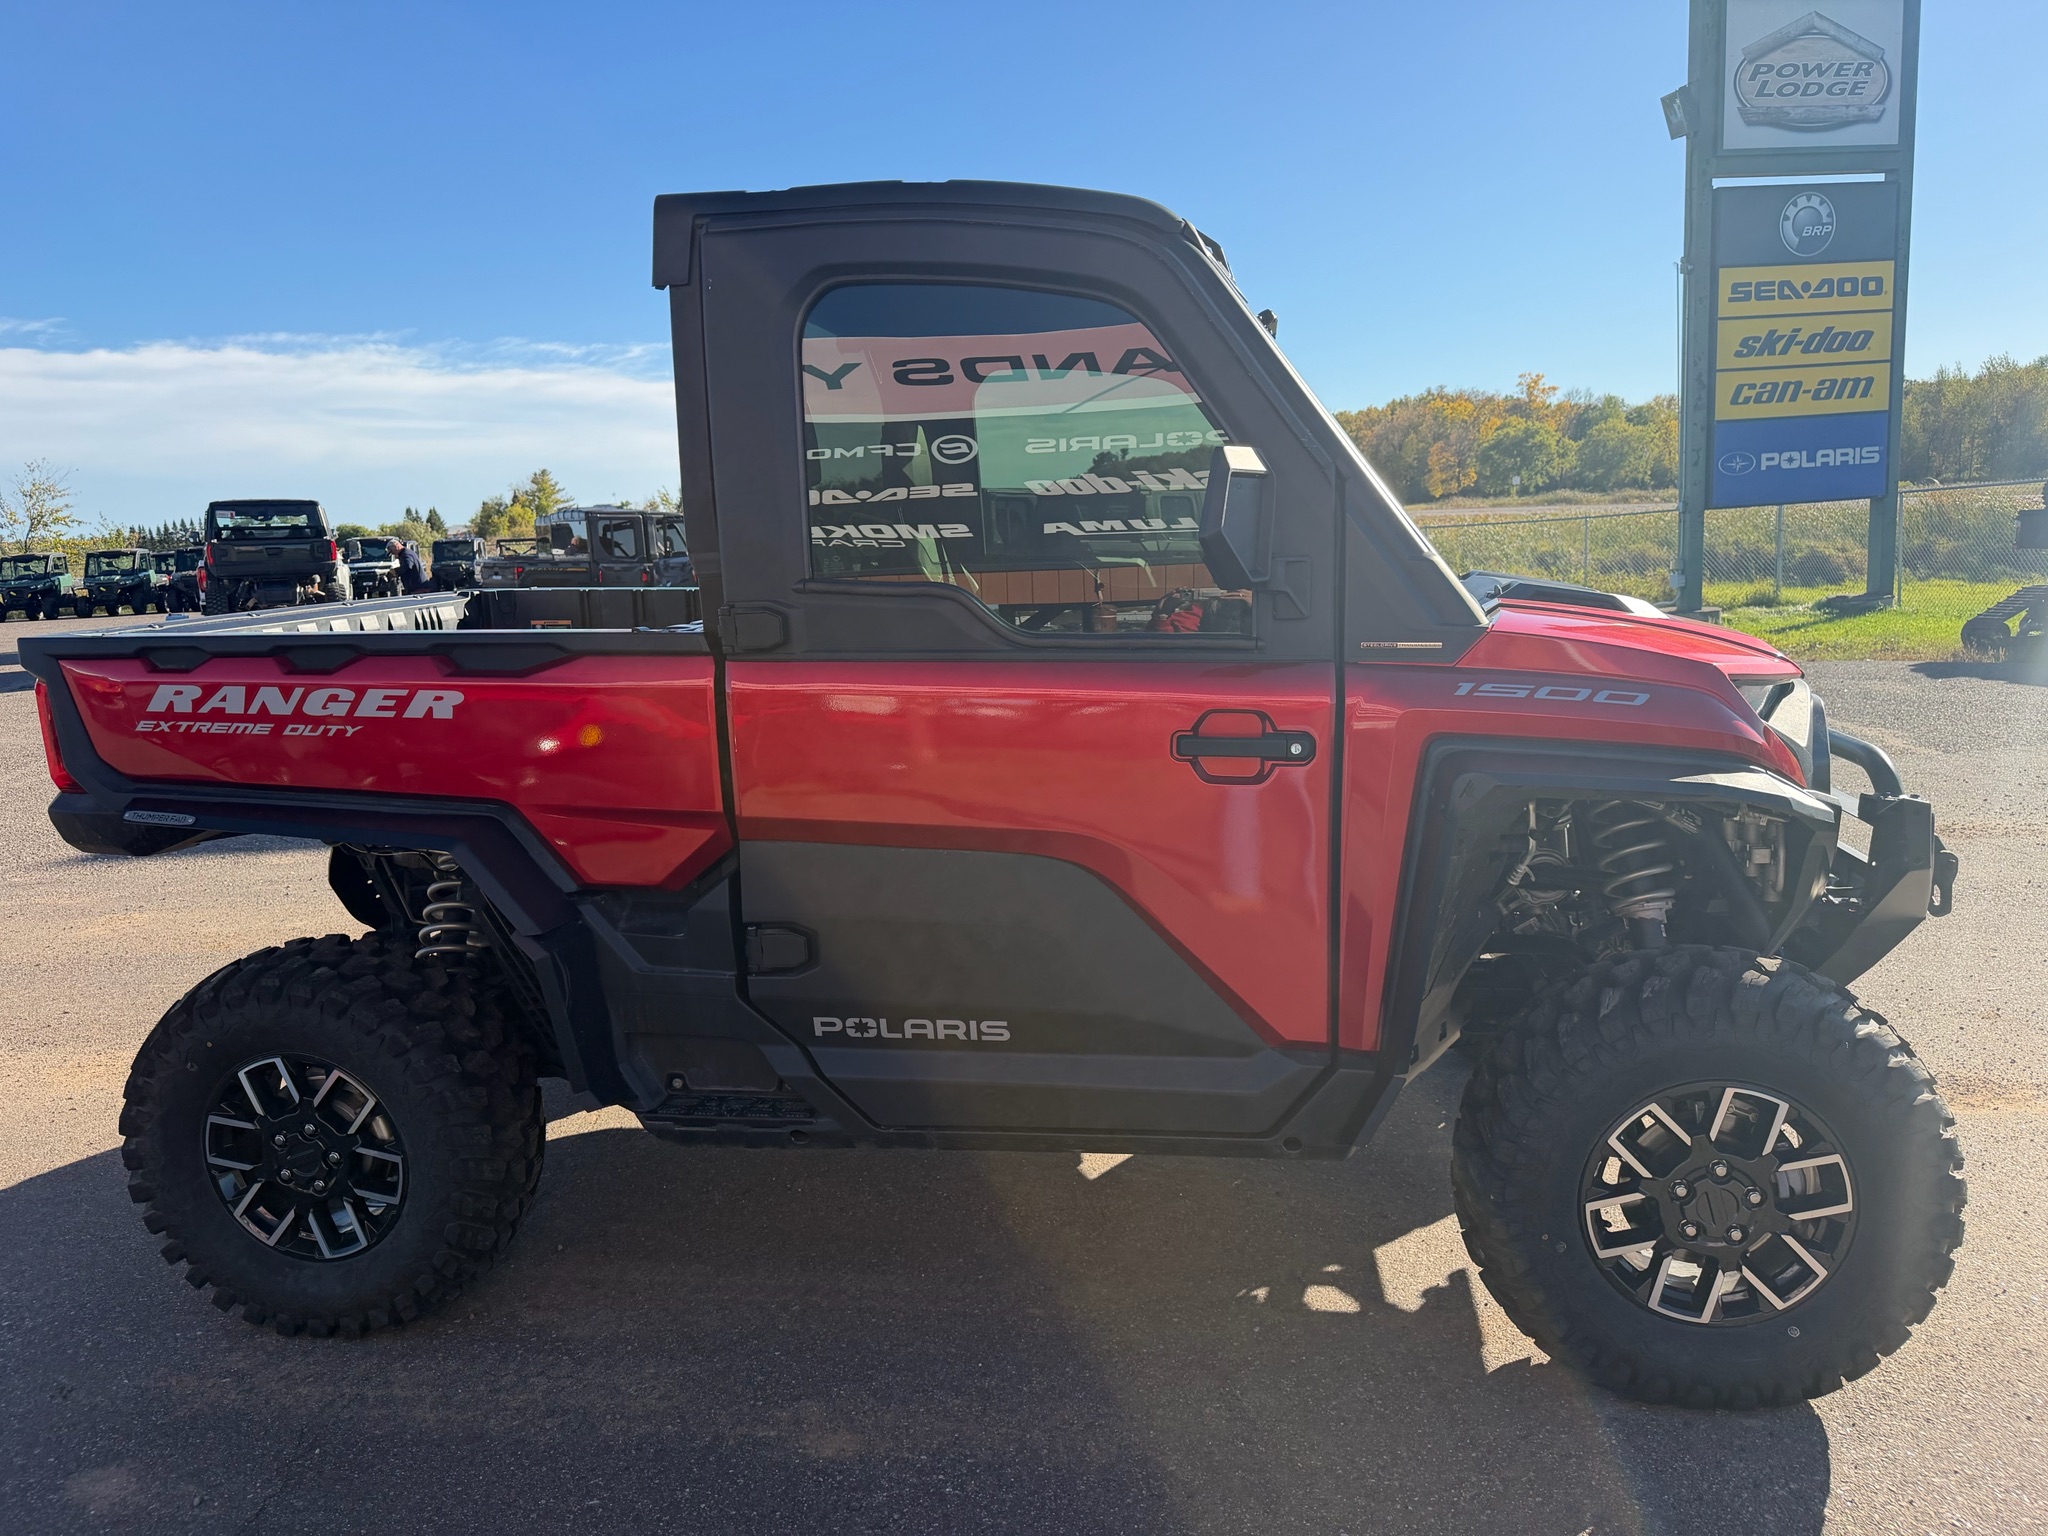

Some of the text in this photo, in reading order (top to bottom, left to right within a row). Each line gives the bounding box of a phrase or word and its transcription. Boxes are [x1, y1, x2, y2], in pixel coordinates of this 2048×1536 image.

[1747, 61, 1875, 82] POWER
[1753, 79, 1870, 98] LODGE
[1801, 224, 1833, 238] BRP
[1733, 326, 1875, 358] ski-doo
[1729, 375, 1875, 406] can-am
[1760, 446, 1880, 471] POLARIS
[146, 684, 465, 720] RANGER
[1454, 682, 1650, 706] 1500
[135, 720, 364, 737] EXTREME DUTY
[132, 811, 169, 822] THUMPER
[812, 1016, 1011, 1042] POLARIS
